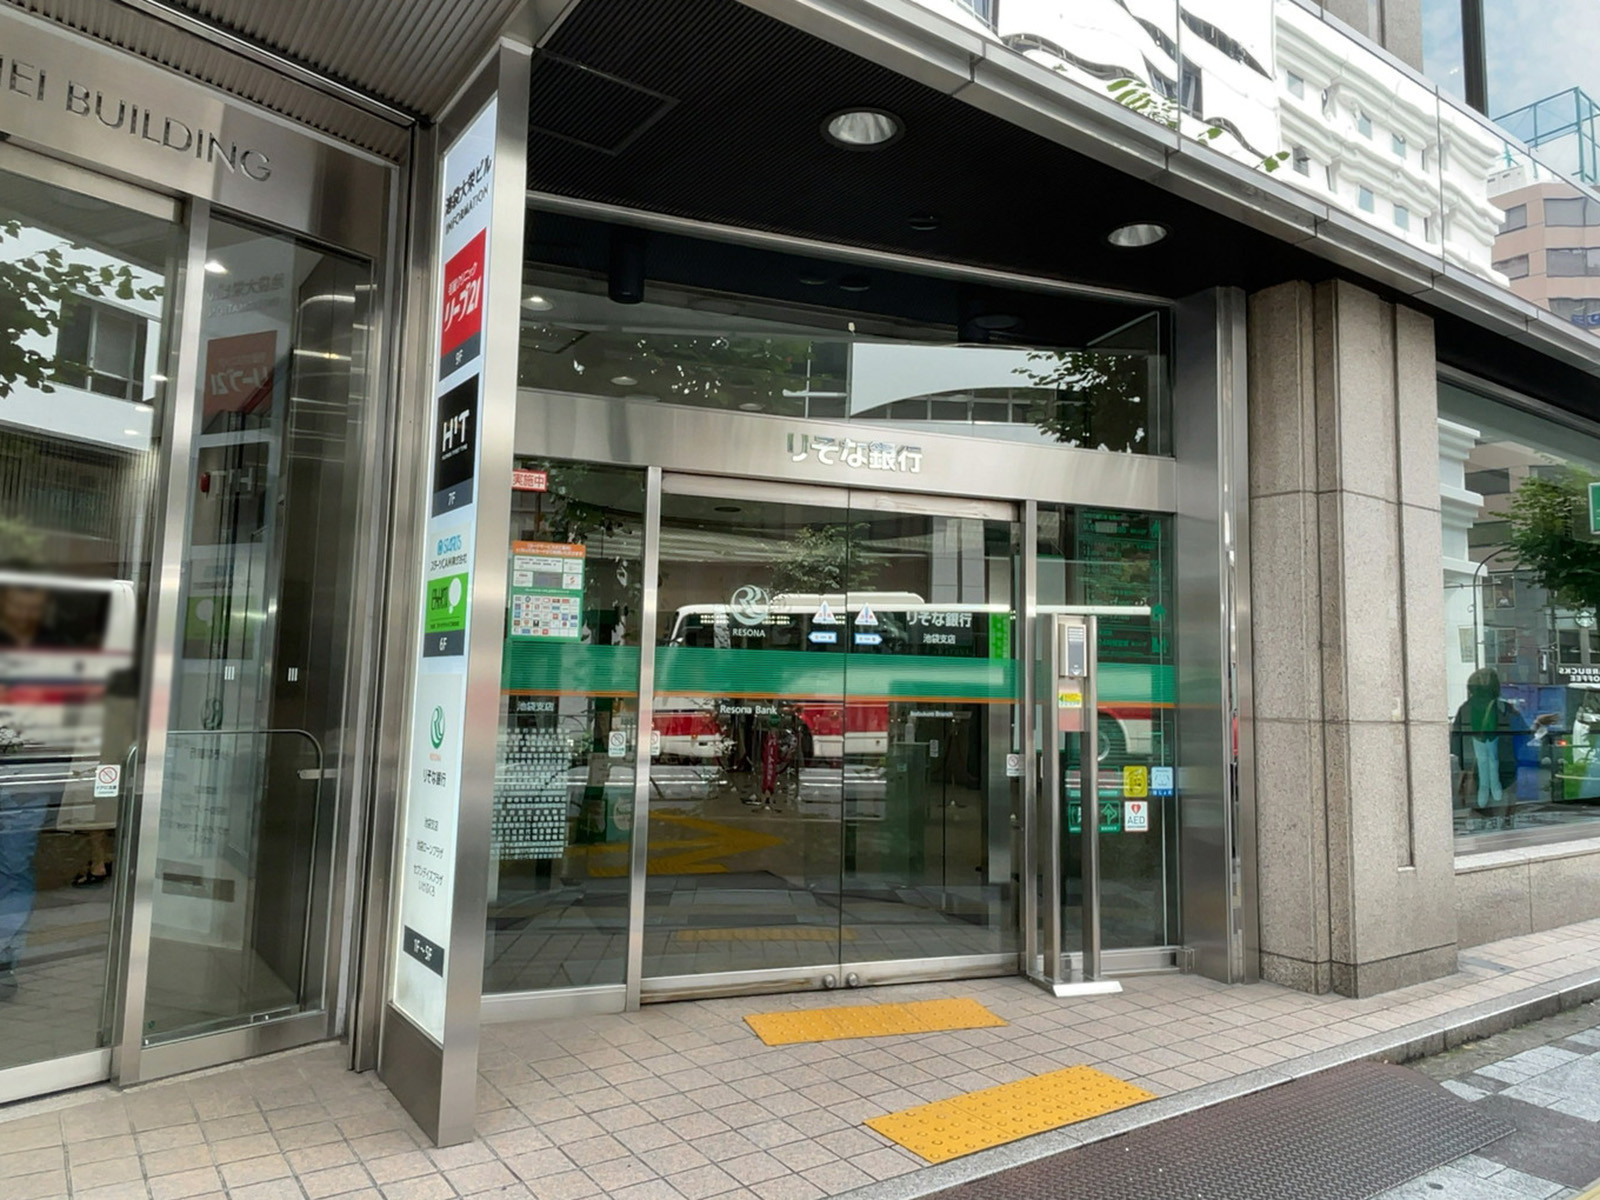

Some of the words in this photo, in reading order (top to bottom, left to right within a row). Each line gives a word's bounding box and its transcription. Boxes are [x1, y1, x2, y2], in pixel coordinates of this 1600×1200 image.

[66, 80, 272, 182] BUILDING
[445, 182, 489, 235] INFORMATION
[444, 276, 482, 333] リーブ21
[454, 348, 464, 366] 9F
[786, 432, 924, 474] りそな銀行
[512, 472, 546, 489] 実施中
[447, 491, 457, 506] 7F
[906, 611, 973, 628] りそな銀行
[732, 628, 767, 638] RESONA
[923, 633, 956, 645] 池袋支店
[439, 636, 448, 652] 6F
[516, 701, 555, 712] 池袋支店
[720, 705, 753, 715] Resona
[755, 705, 778, 716] Bank
[422, 768, 447, 788] りそな銀行
[1127, 815, 1146, 825] AED
